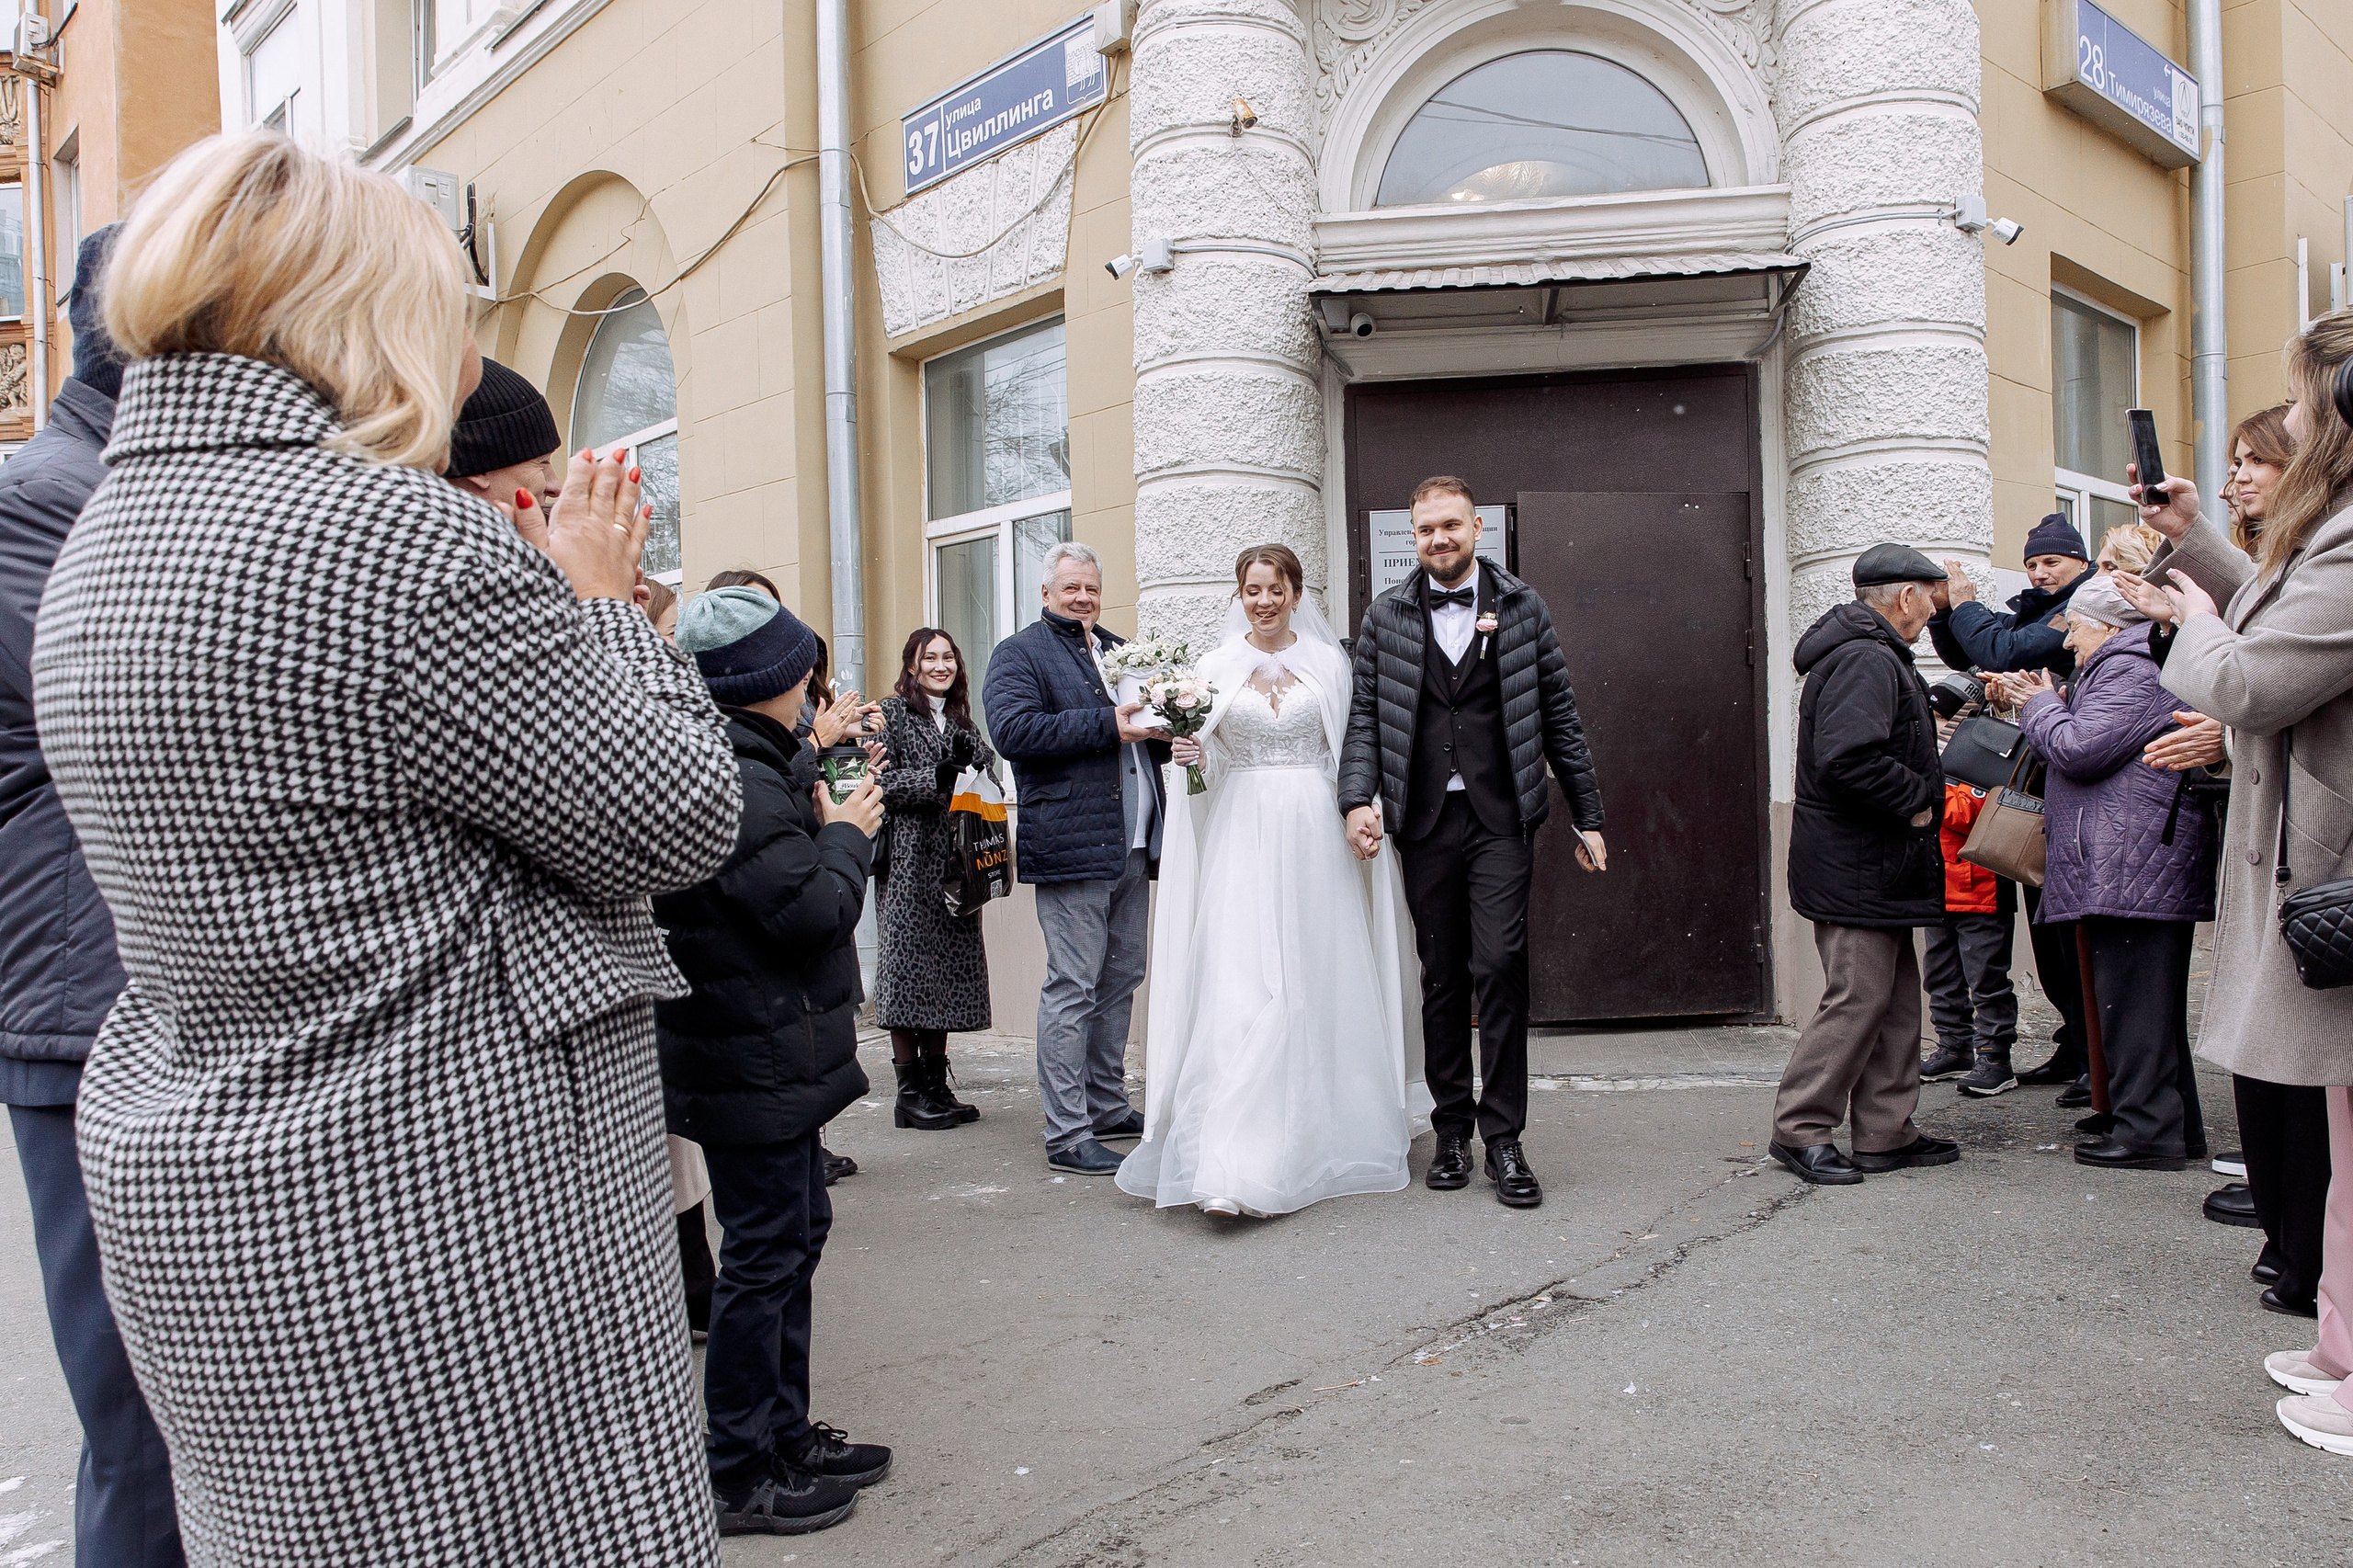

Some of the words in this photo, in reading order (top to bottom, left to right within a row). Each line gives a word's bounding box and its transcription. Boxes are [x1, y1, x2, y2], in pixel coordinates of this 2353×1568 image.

[2080, 35, 2105, 90] 28
[945, 97, 982, 131] улица
[2108, 71, 2172, 135] Тимирязева
[2153, 85, 2171, 108] улица
[947, 88, 1053, 159] Цвиллинга
[908, 120, 938, 176] 37
[1378, 528, 1415, 538] Управлен
[1405, 539, 1417, 547] гор
